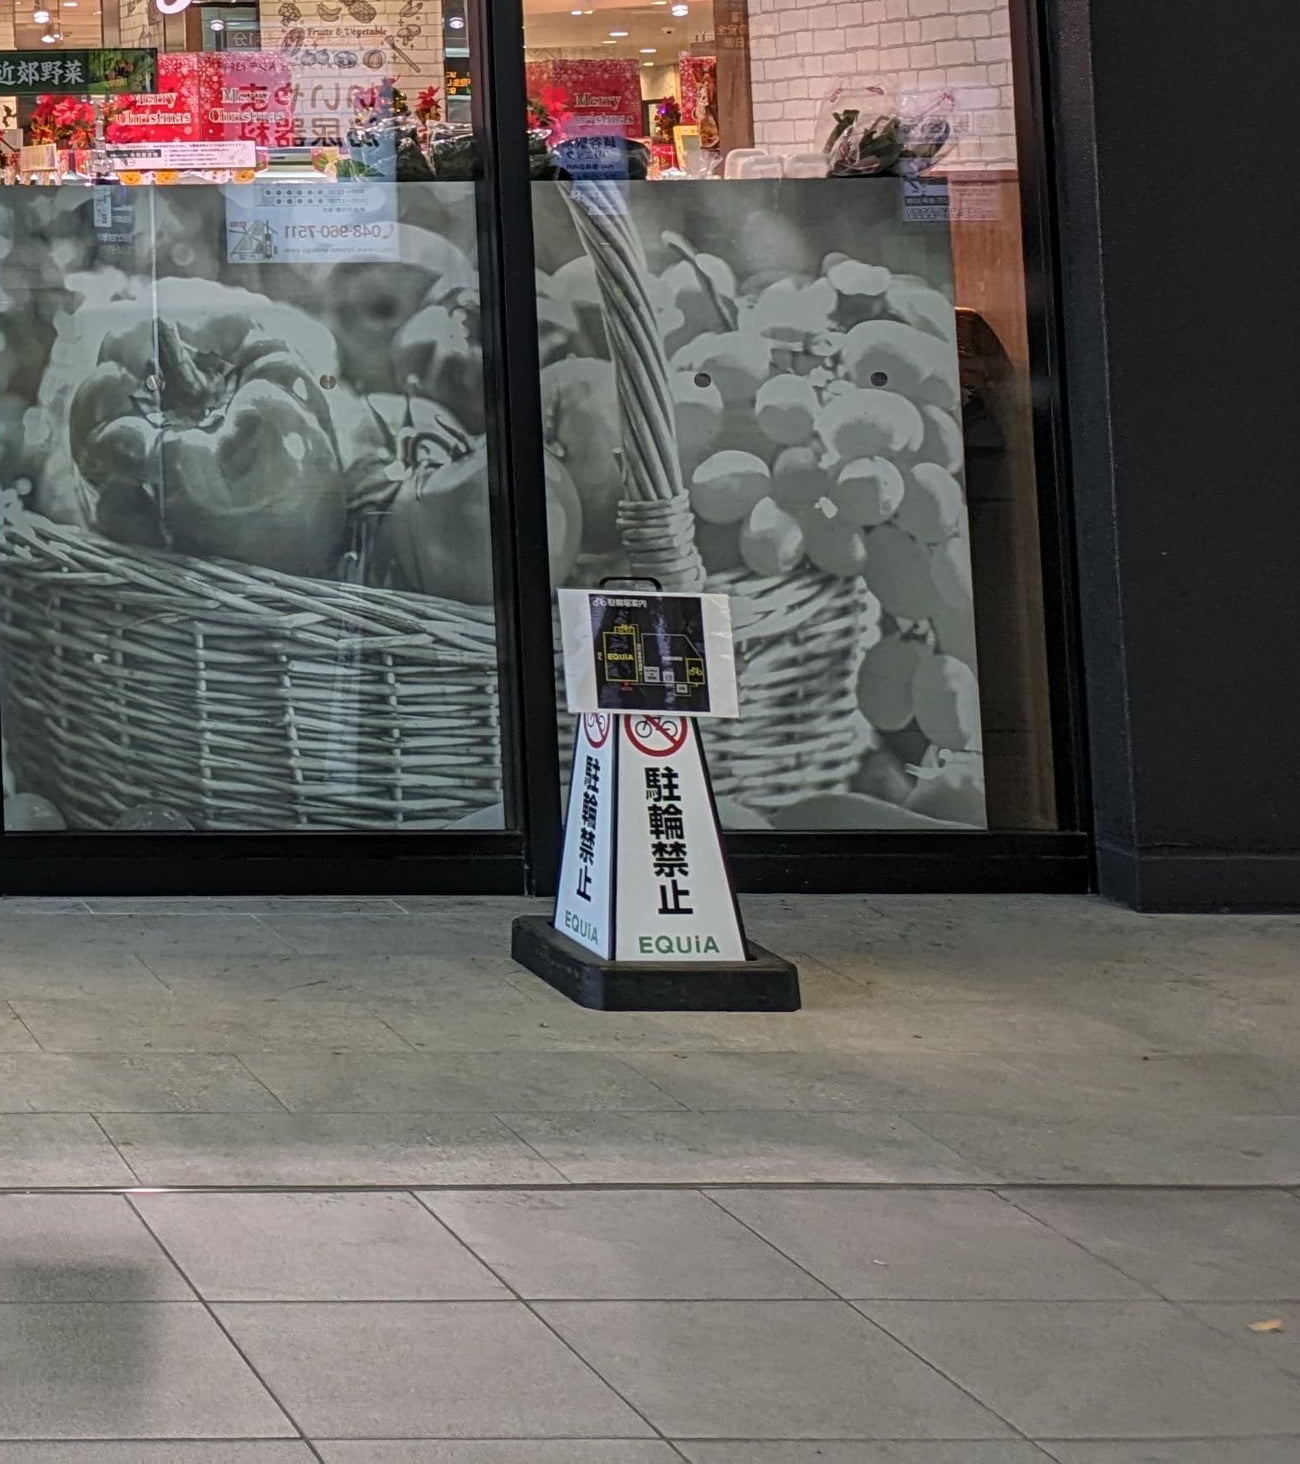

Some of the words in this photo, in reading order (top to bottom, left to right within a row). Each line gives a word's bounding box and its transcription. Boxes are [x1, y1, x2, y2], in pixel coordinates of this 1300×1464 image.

[307, 27, 332, 36] Fruits
[344, 25, 388, 38] Vegetable
[115, 109, 192, 126] Christmas
[644, 766, 694, 916] 駐輪禁止
